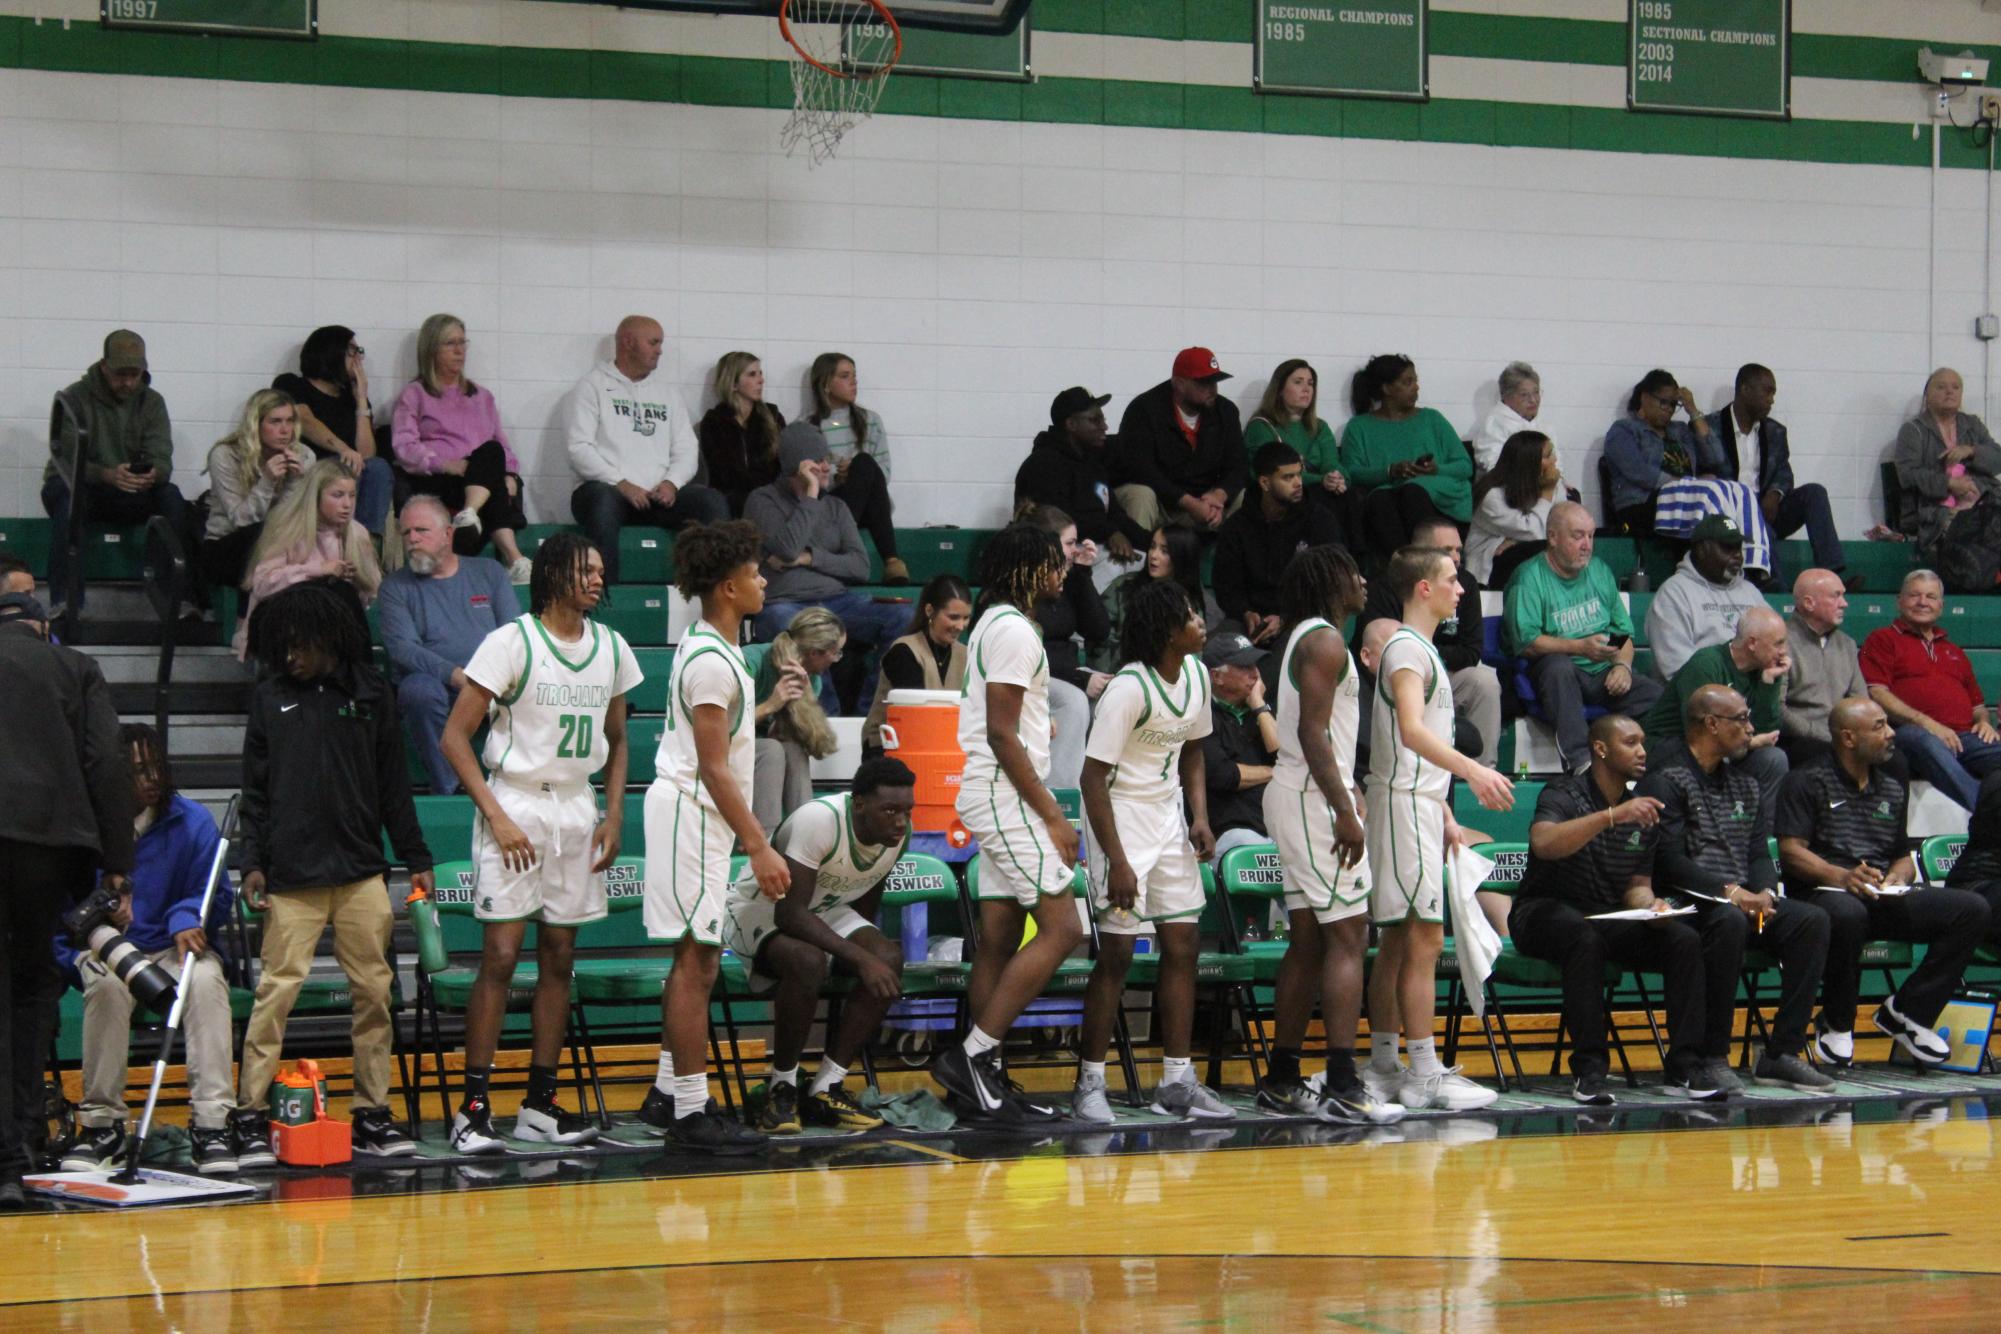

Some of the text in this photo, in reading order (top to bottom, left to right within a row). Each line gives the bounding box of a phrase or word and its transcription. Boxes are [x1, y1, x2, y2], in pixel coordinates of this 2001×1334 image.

[113, 0, 158, 19] 1997
[1269, 6, 1415, 26] REGIONAL CHAMPIONS
[1638, 2, 1672, 20] 1985
[856, 24, 894, 39] 198
[1265, 22, 1305, 41] 1985
[1642, 26, 1776, 46] SECTIONAL CHAMPIONS
[1638, 43, 1674, 61] 2003
[1638, 64, 1673, 82] 2014
[536, 683, 611, 708] TROJANS
[557, 714, 593, 758] 20
[604, 865, 637, 881] EST
[286, 1099, 301, 1118] G
